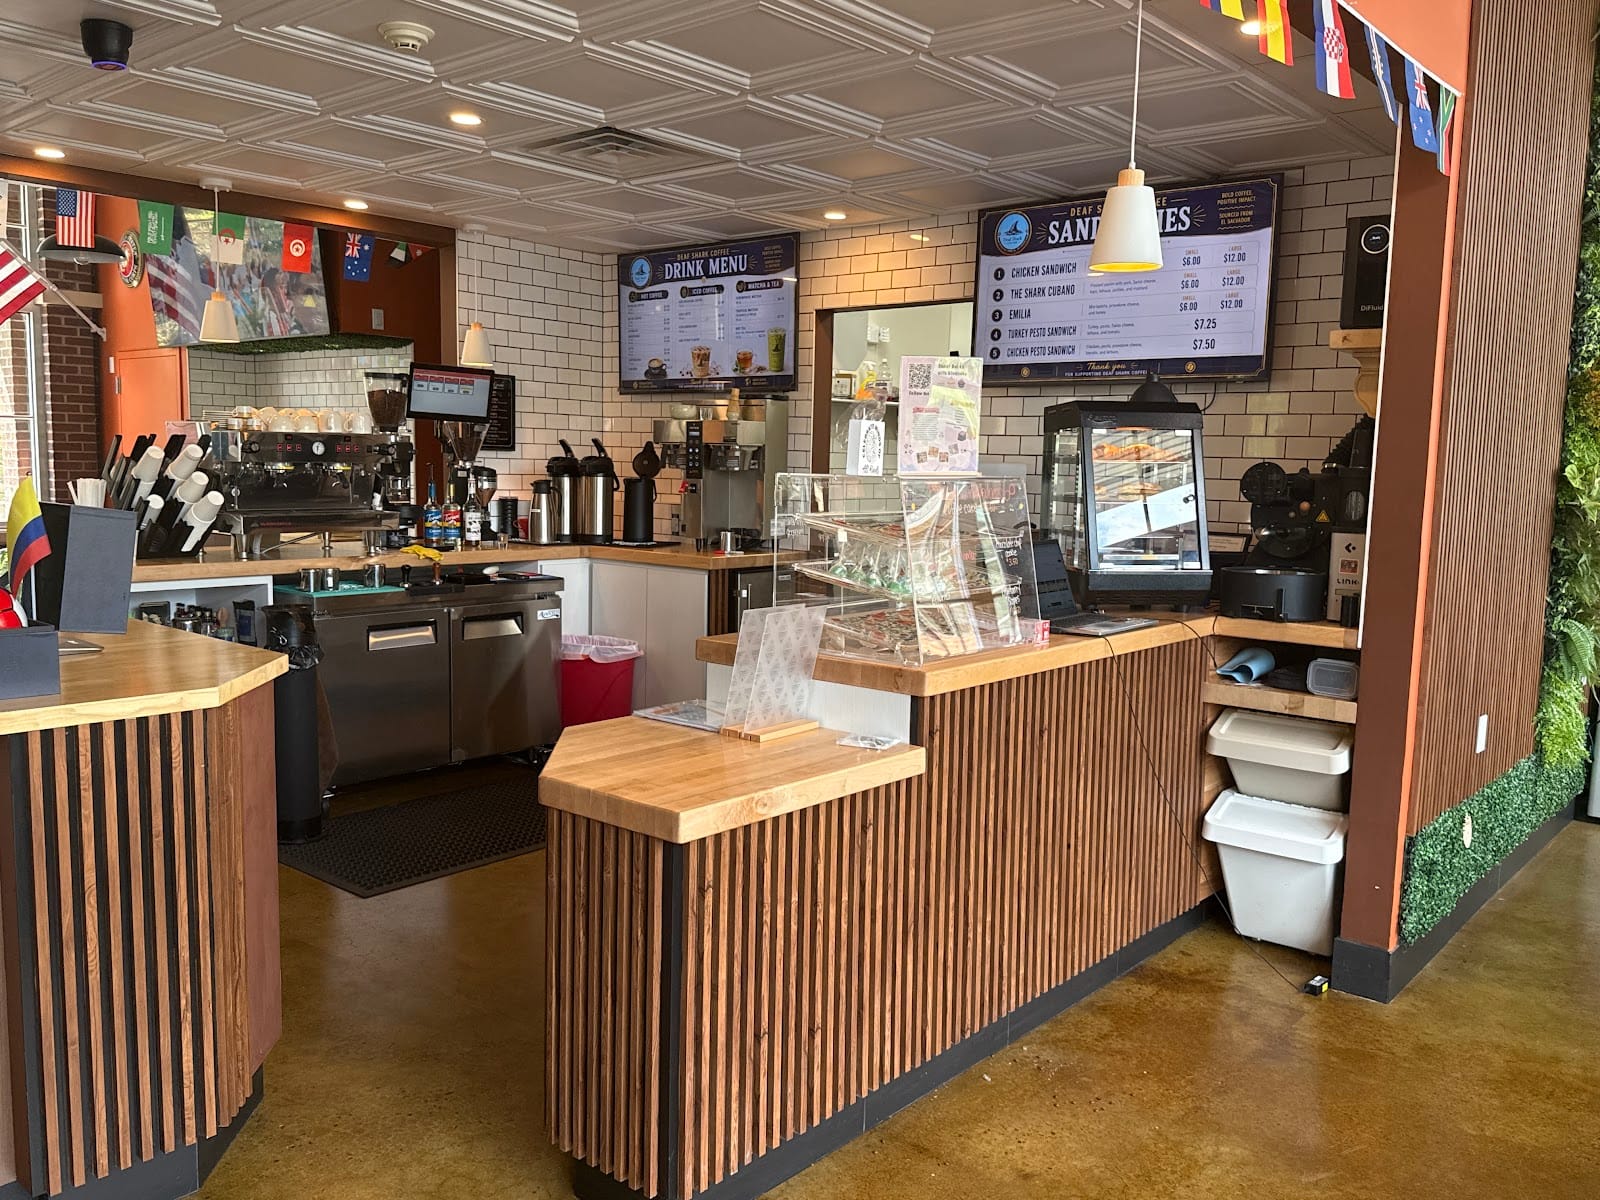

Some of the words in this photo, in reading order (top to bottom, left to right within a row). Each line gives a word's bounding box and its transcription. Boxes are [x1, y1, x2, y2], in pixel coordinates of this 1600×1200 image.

[1070, 206, 1093, 217] DEAF
[677, 253, 690, 261] DEAF
[692, 250, 709, 259] SHARK
[710, 248, 730, 257] COFFEE
[1182, 255, 1201, 266] $6.00
[1223, 252, 1246, 263] $12.00
[664, 259, 705, 280] DRINK
[709, 254, 748, 275] MENU
[1011, 265, 1040, 278] CHICKEN
[1041, 261, 1077, 276] SANDWICH
[1180, 279, 1200, 289] $6.00
[1221, 276, 1245, 287] $12.00
[1011, 288, 1022, 299] THE
[1024, 286, 1046, 299] SHARK
[1048, 284, 1075, 297] CUBANO
[1179, 301, 1198, 312] $6.00
[1220, 299, 1243, 309] $12.00
[1360, 304, 1384, 312] DiFluid
[1009, 308, 1031, 320] EMILIA
[1194, 318, 1217, 330] $7.25
[1008, 328, 1029, 339] TURKEY
[1029, 327, 1046, 338] PESTO
[1047, 325, 1077, 337] SANDWICH
[1193, 338, 1216, 350] $7.50
[1006, 347, 1029, 357] CHICKEN
[1030, 346, 1046, 357] PESTO
[1047, 344, 1076, 356] SANDWICH
[1087, 361, 1111, 370] Thank
[1111, 361, 1127, 373] you
